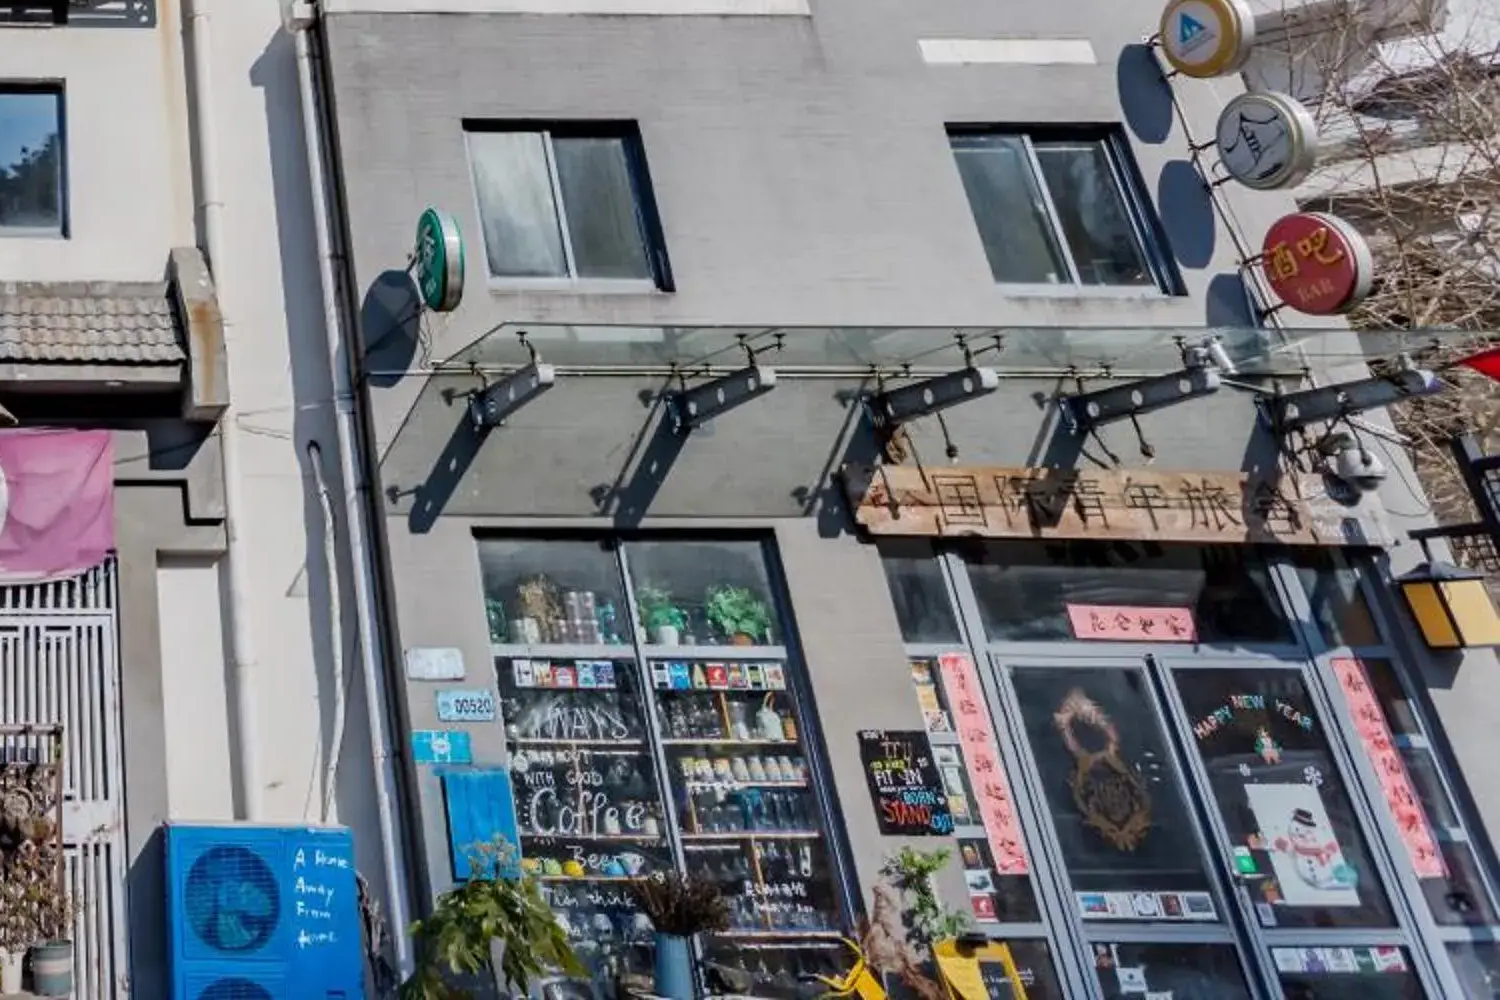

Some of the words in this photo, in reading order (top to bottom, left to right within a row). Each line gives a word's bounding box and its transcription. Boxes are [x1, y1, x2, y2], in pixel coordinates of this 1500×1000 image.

[1268, 225, 1345, 281] 酒吧
[1229, 695, 1265, 710] NEW
[1275, 698, 1313, 732] YEAR
[1193, 705, 1233, 740] HAPPY
[524, 771, 555, 785] WITH
[881, 797, 930, 826] STAND
[293, 848, 305, 872] A
